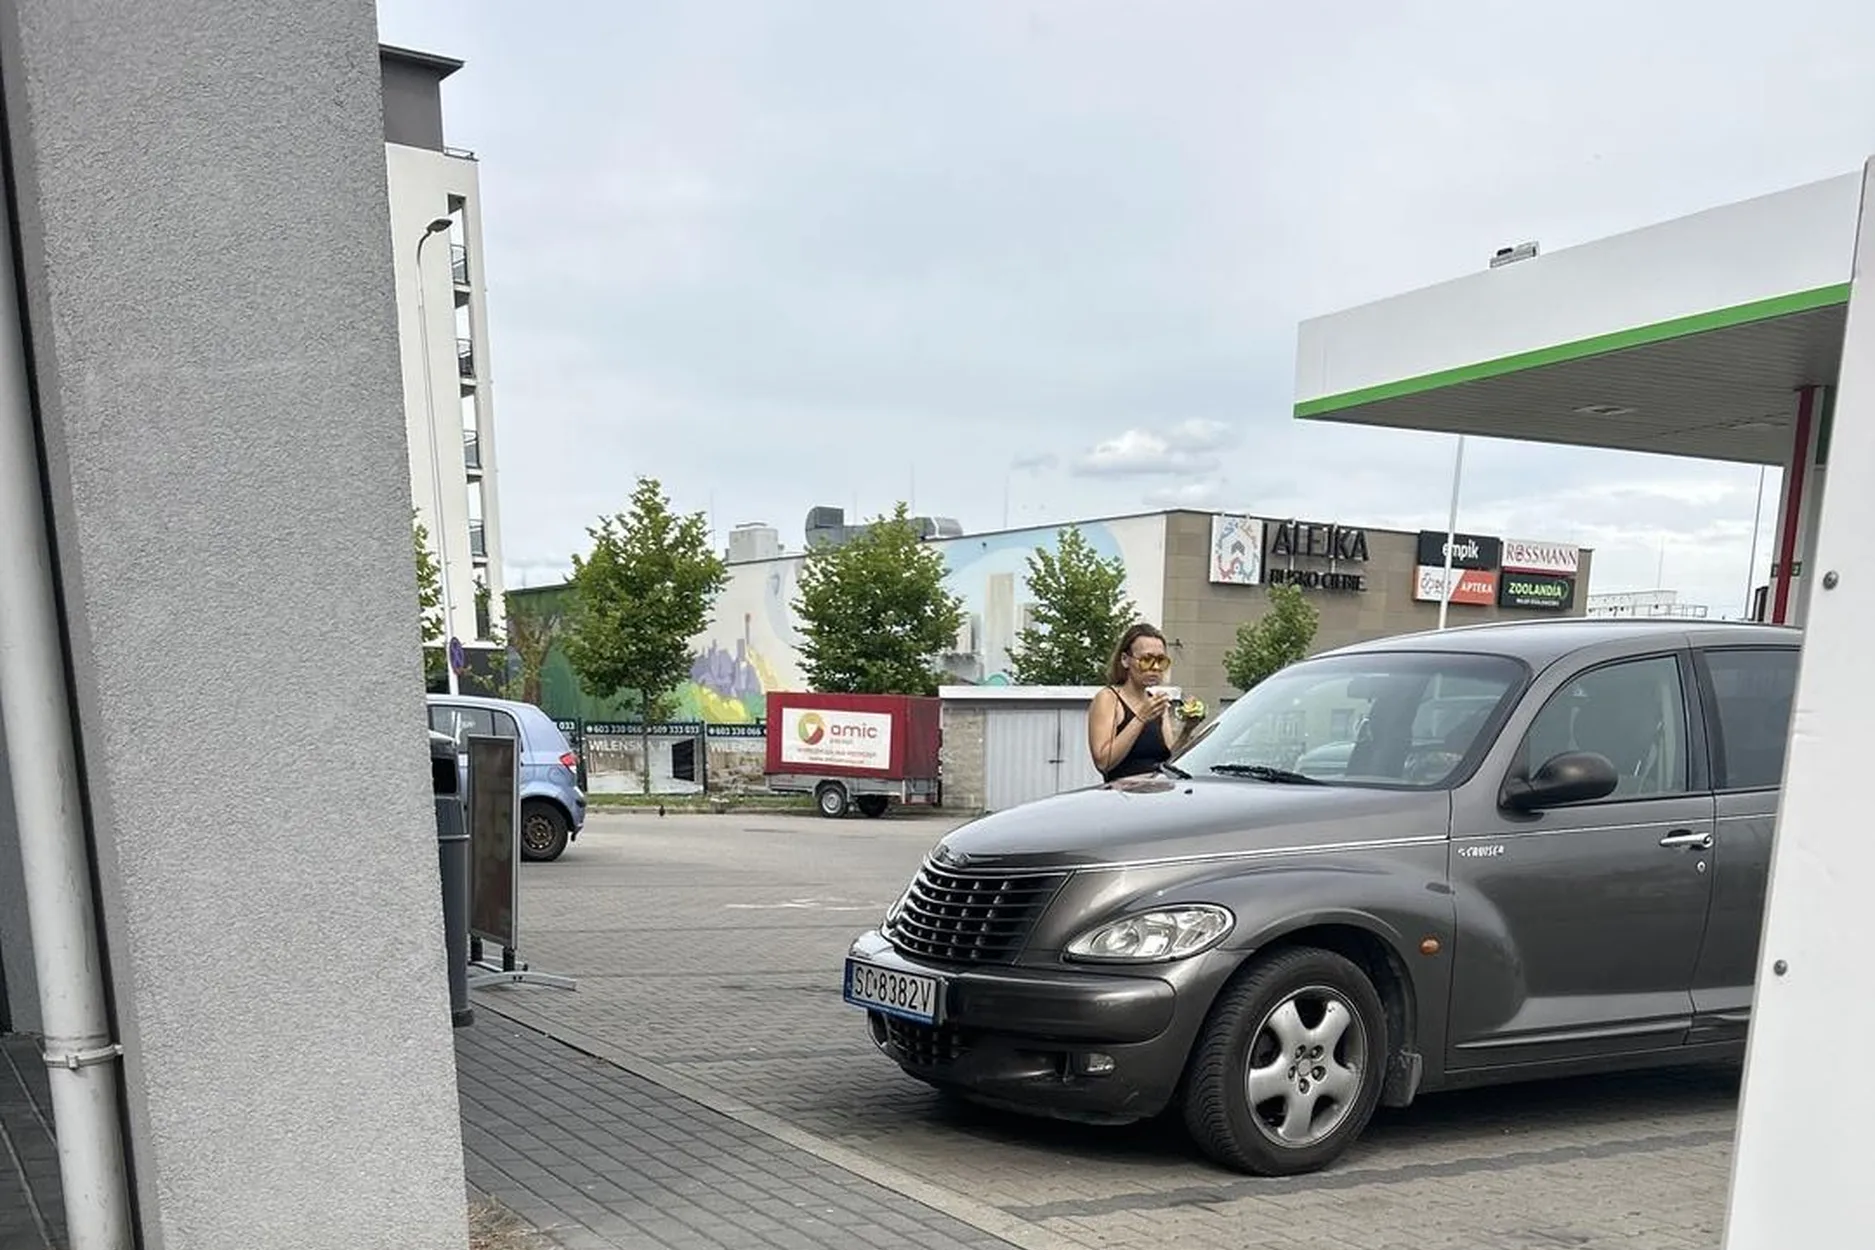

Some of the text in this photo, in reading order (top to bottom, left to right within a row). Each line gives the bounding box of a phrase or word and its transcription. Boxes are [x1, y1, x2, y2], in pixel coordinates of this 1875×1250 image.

[1442, 539, 1479, 561] empik
[1506, 543, 1576, 565] ROSSMANN
[1461, 581, 1493, 593] APTEKA
[1508, 582, 1562, 597] ZOOLANDIA
[830, 722, 878, 739] amic
[855, 966, 932, 1012] SC 8382V
